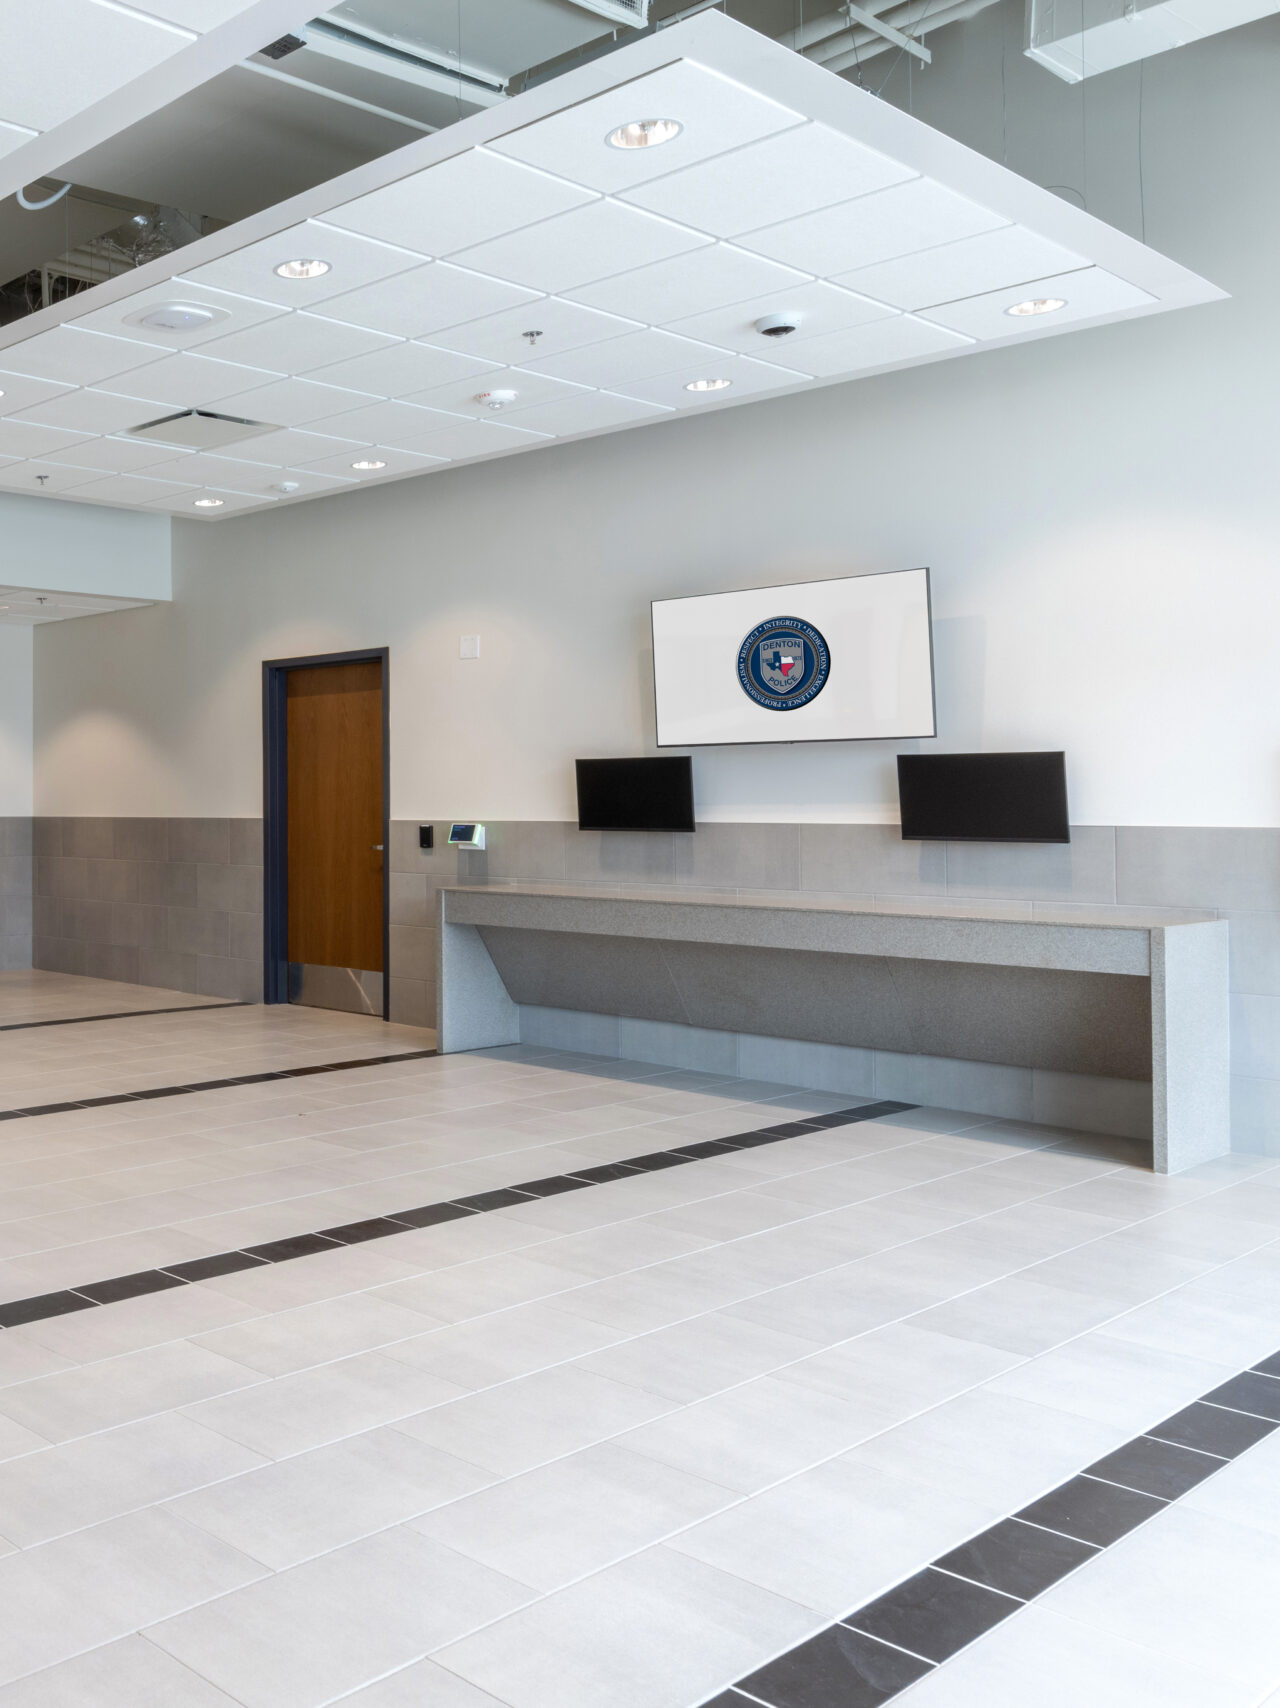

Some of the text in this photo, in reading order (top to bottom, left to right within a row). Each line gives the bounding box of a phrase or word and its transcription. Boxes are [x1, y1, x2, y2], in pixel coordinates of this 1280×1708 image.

[763, 619, 802, 630] INTEGRITY
[740, 630, 759, 658] RESPECT
[762, 640, 801, 651] DENTON
[805, 627, 827, 670] DEDICATION
[739, 663, 782, 708] PROFESSIONALISM
[769, 674, 797, 687] POLICE
[787, 674, 824, 708] EXCELLENCE
